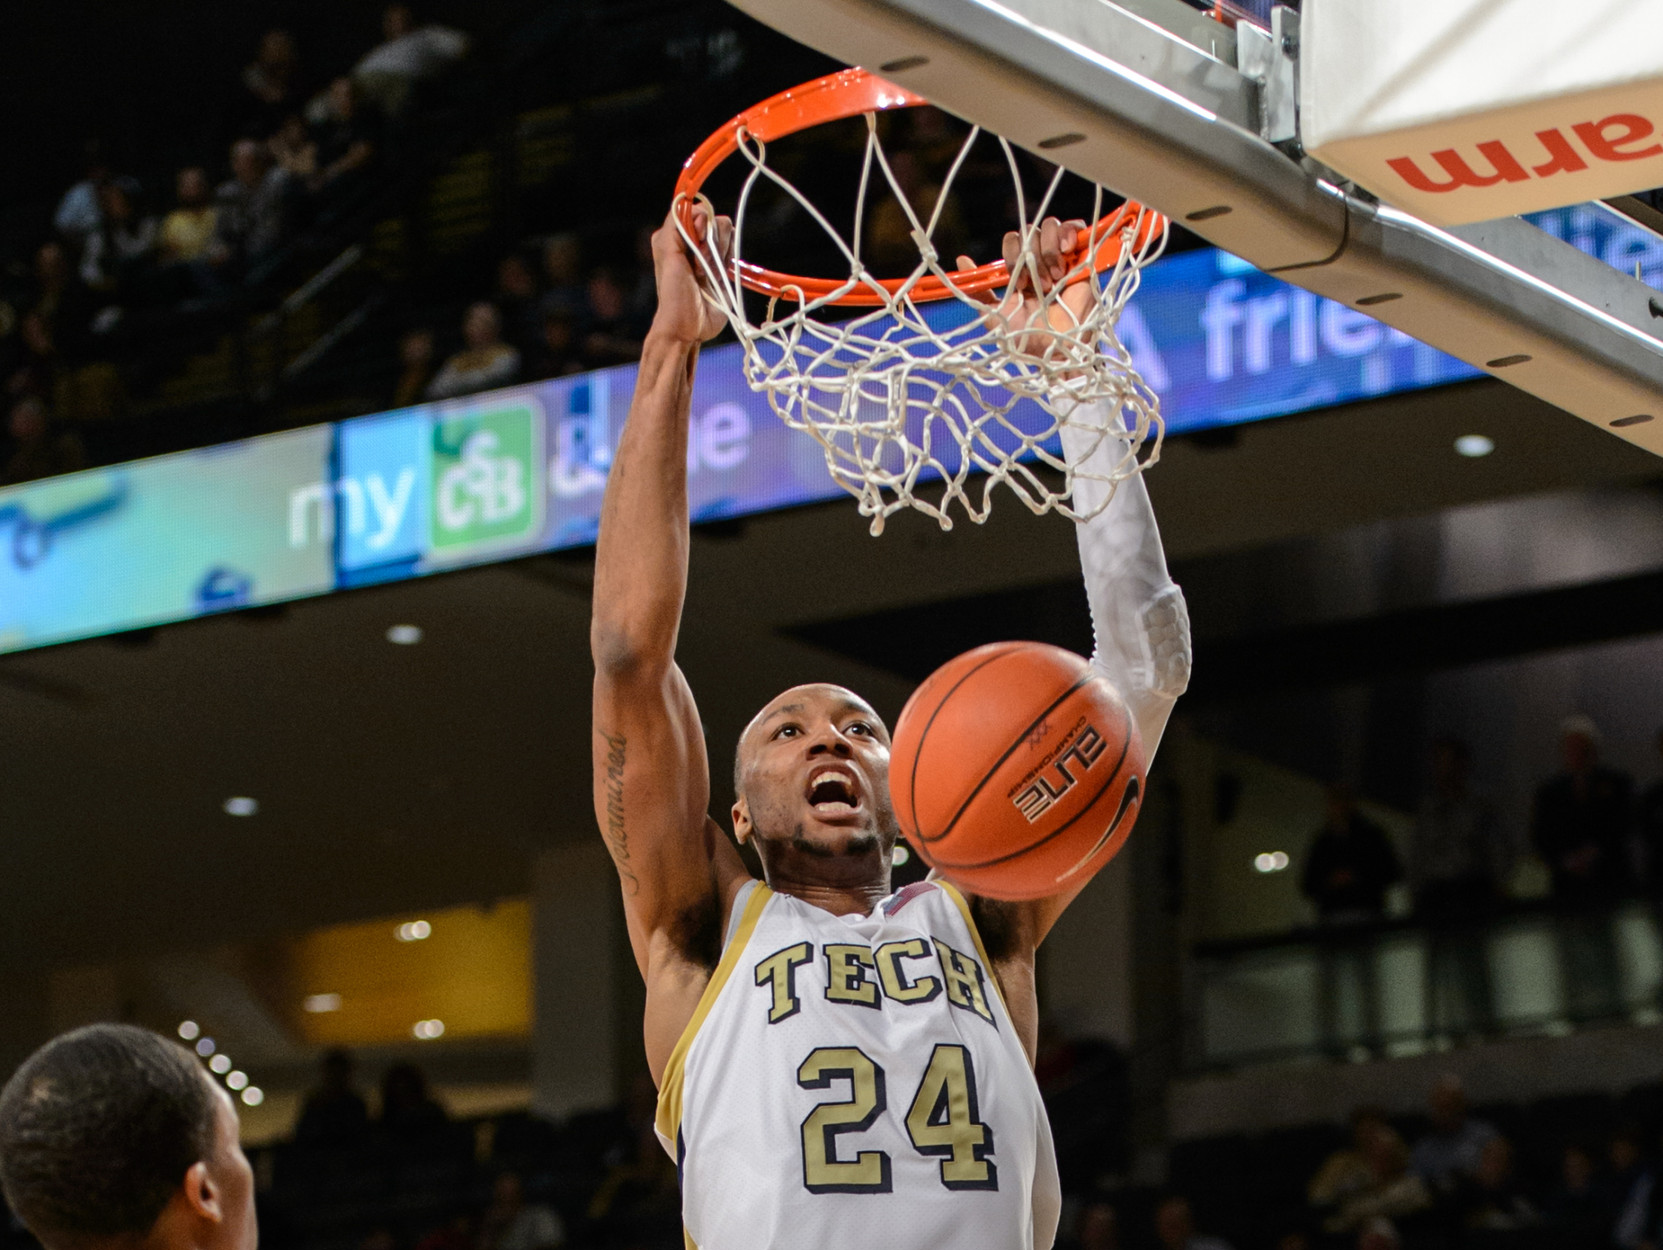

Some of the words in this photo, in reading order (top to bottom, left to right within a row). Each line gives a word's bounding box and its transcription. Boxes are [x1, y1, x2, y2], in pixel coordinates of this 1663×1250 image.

[1385, 113, 1663, 194] arm
[289, 467, 416, 550] my
[1007, 715, 1087, 798] CHAMPIONSHIP
[1012, 724, 1109, 824] ELITE
[754, 935, 999, 1032] TECH
[797, 1042, 999, 1194] 24
